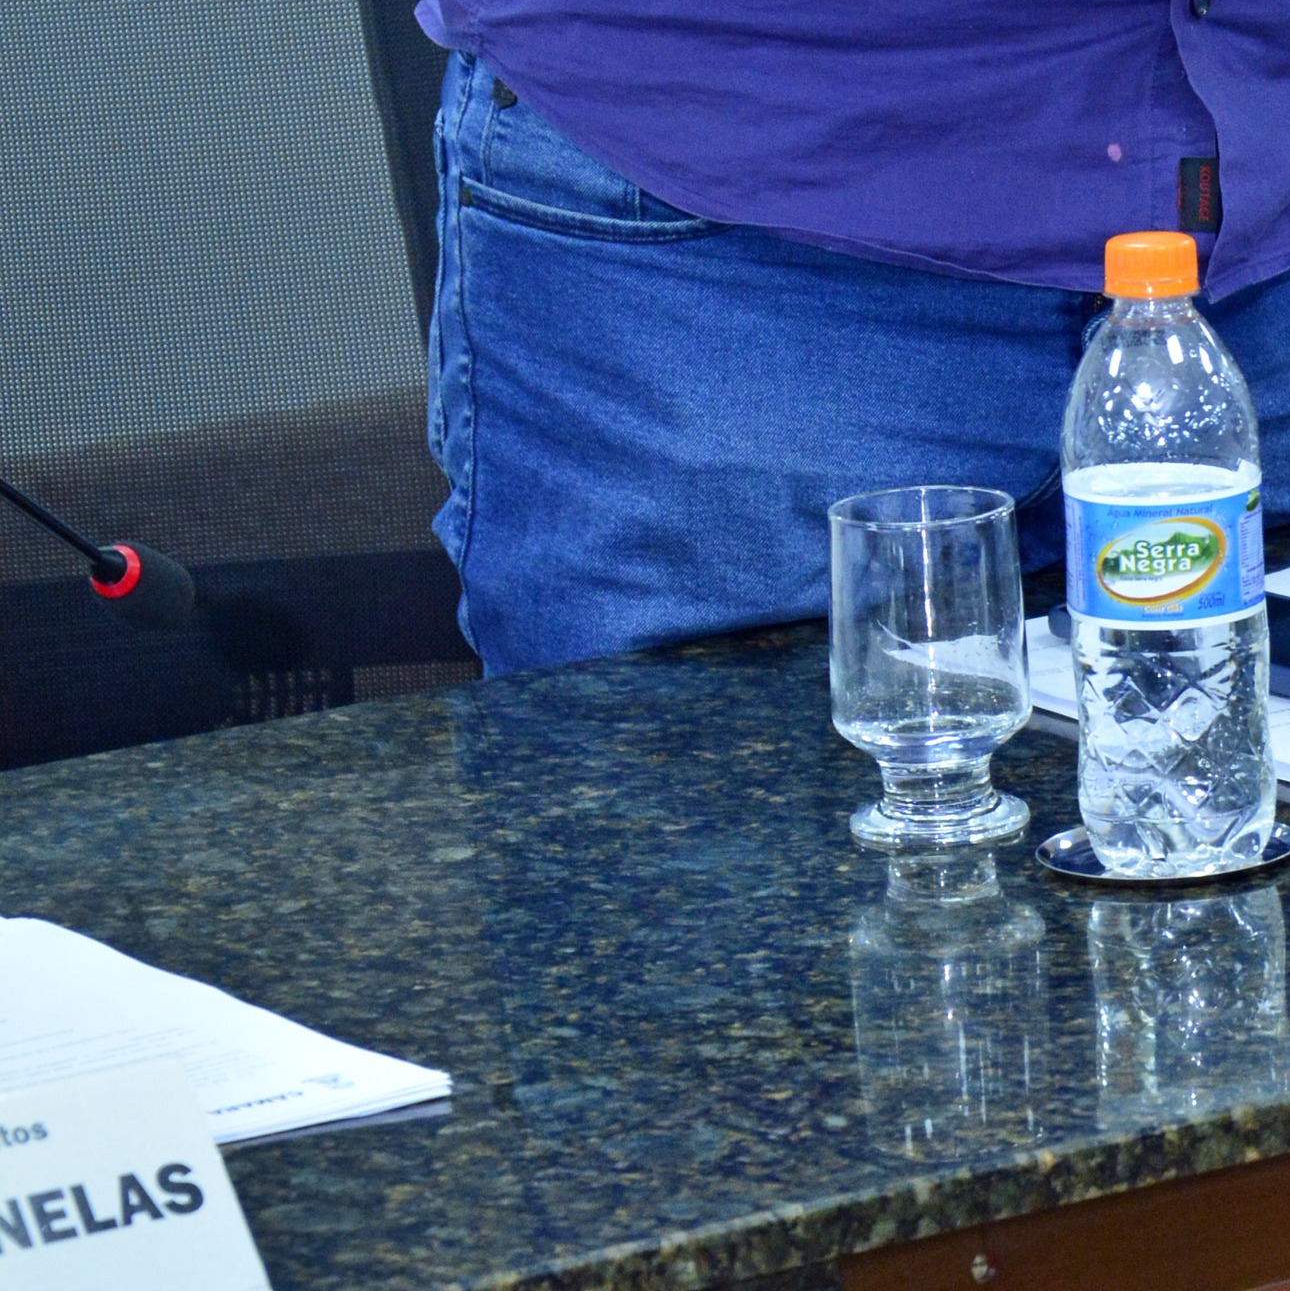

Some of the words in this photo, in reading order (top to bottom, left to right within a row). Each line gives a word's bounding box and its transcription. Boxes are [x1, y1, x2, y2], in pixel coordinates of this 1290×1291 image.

[1133, 506, 1173, 518] Mineral
[1175, 503, 1213, 516] Natural
[1134, 540, 1200, 559] Serra
[1118, 554, 1192, 576] Negra
[0, 1122, 48, 1147] tos
[0, 1162, 205, 1255] NELAS
